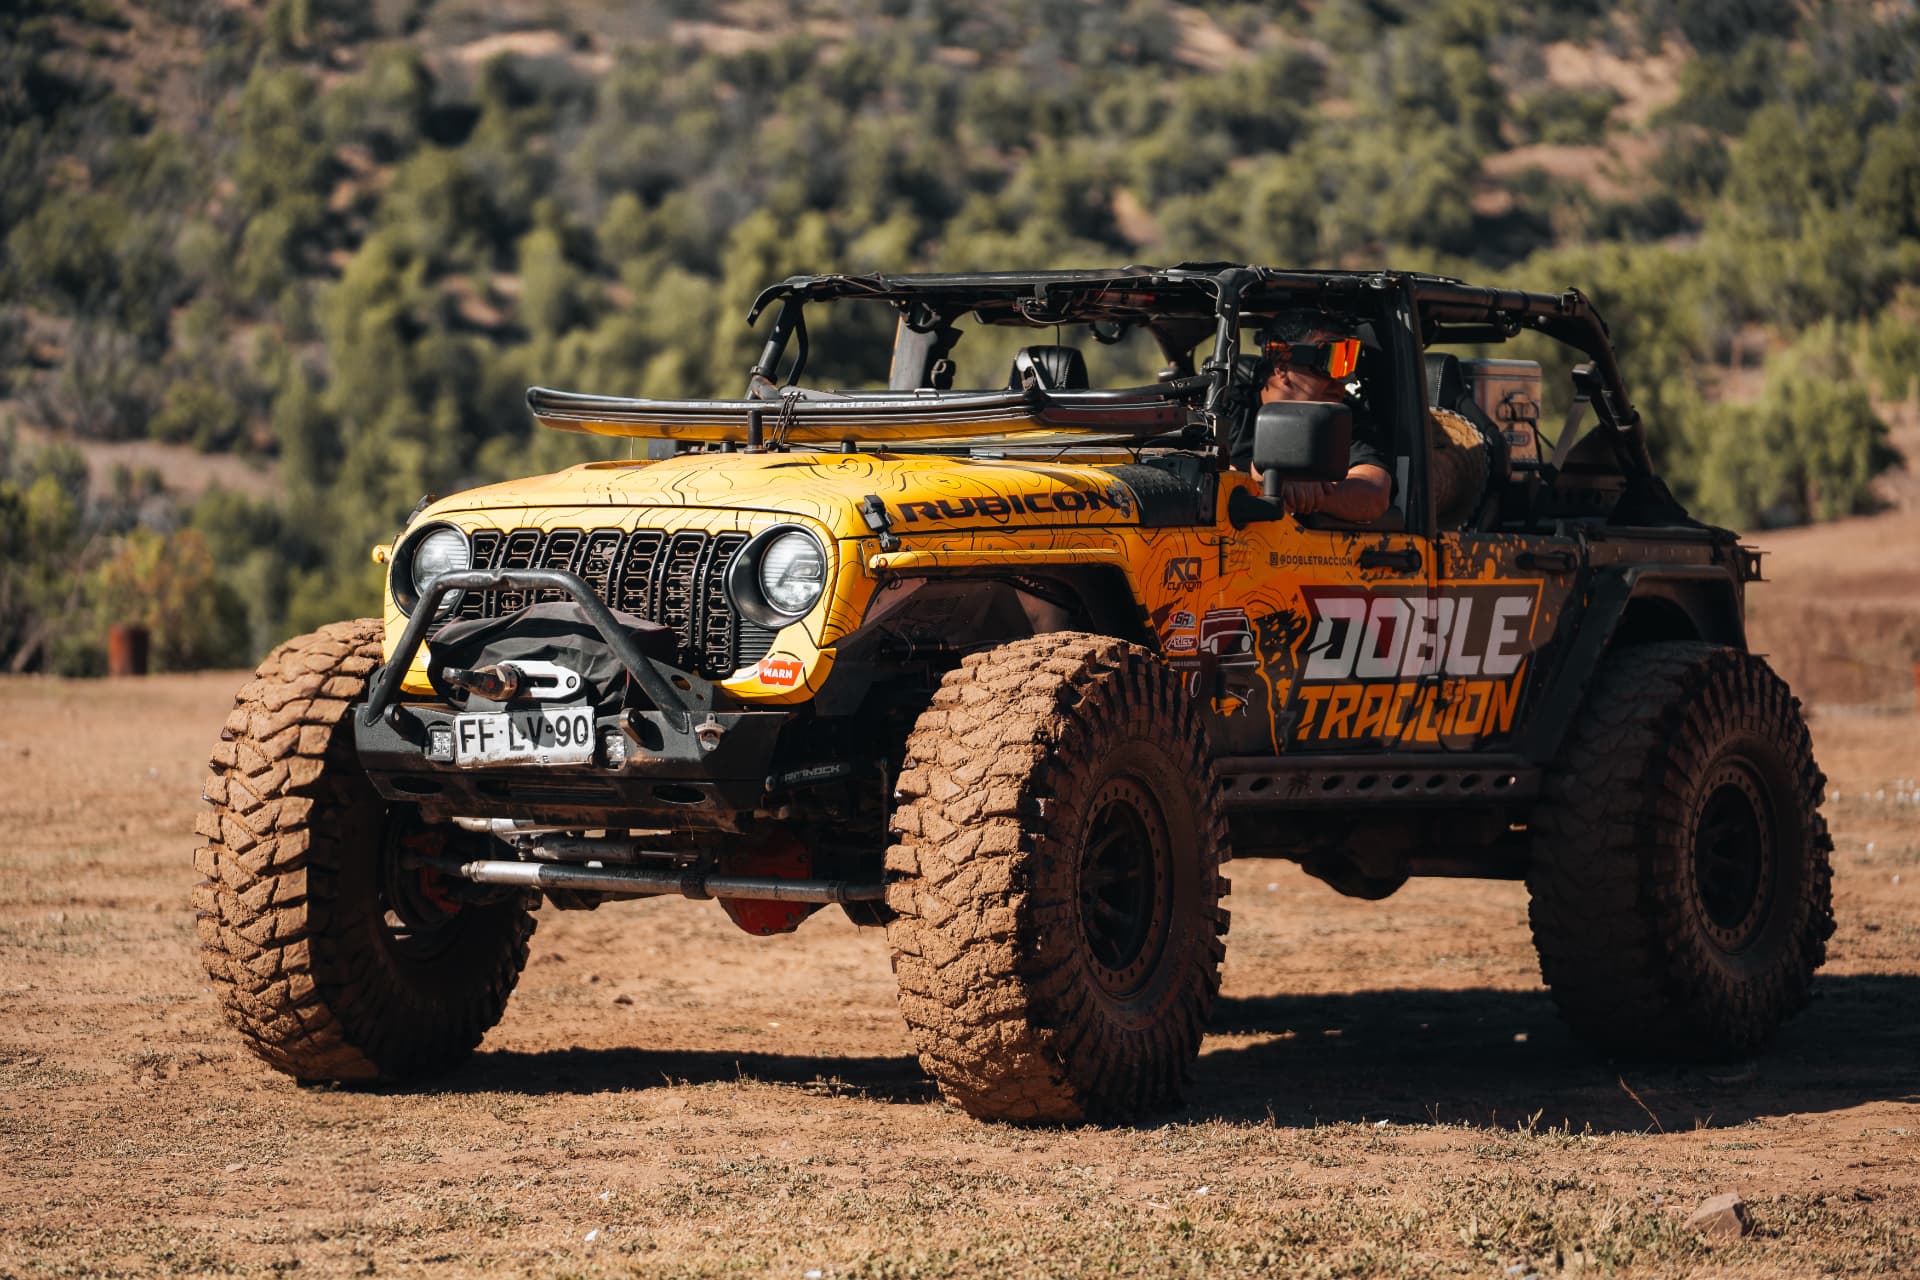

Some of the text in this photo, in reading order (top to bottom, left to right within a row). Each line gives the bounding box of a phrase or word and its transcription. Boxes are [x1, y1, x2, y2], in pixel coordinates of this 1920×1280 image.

[896, 491, 1122, 522] RUBICON
[1280, 556, 1353, 567] @DOBLETRACCION
[1303, 596, 1533, 680] DOBLE
[763, 667, 793, 679] WARN
[1296, 664, 1528, 742] TRACCION
